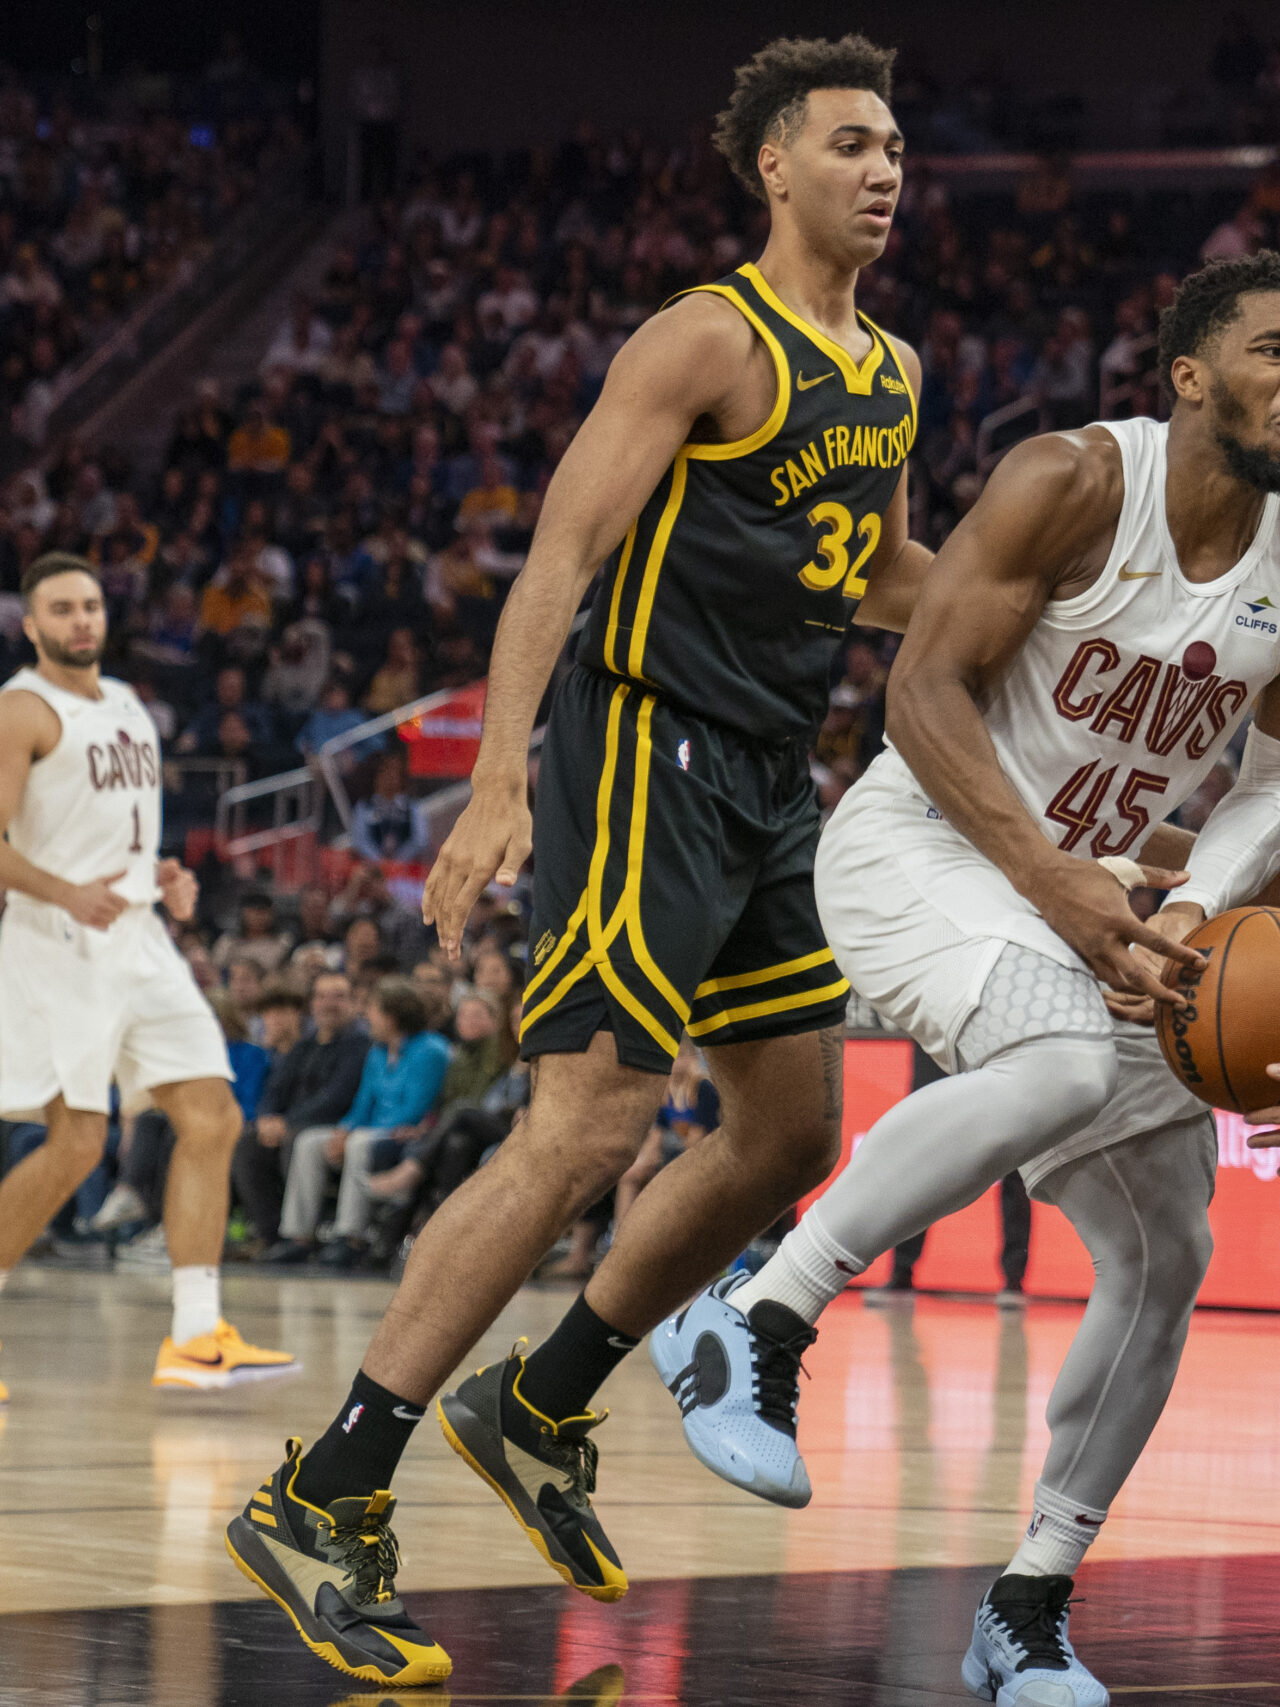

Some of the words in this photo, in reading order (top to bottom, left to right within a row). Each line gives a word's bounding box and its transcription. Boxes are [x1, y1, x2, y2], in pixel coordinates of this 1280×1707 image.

[771, 441, 827, 506] SAN
[823, 414, 912, 469] FRANCISCO
[797, 501, 882, 600] 32
[1235, 615, 1278, 634] CLIFFS
[1052, 637, 1247, 760] CAVS
[87, 740, 158, 792] CAVS
[1044, 757, 1170, 858] 45
[128, 801, 143, 854] 1
